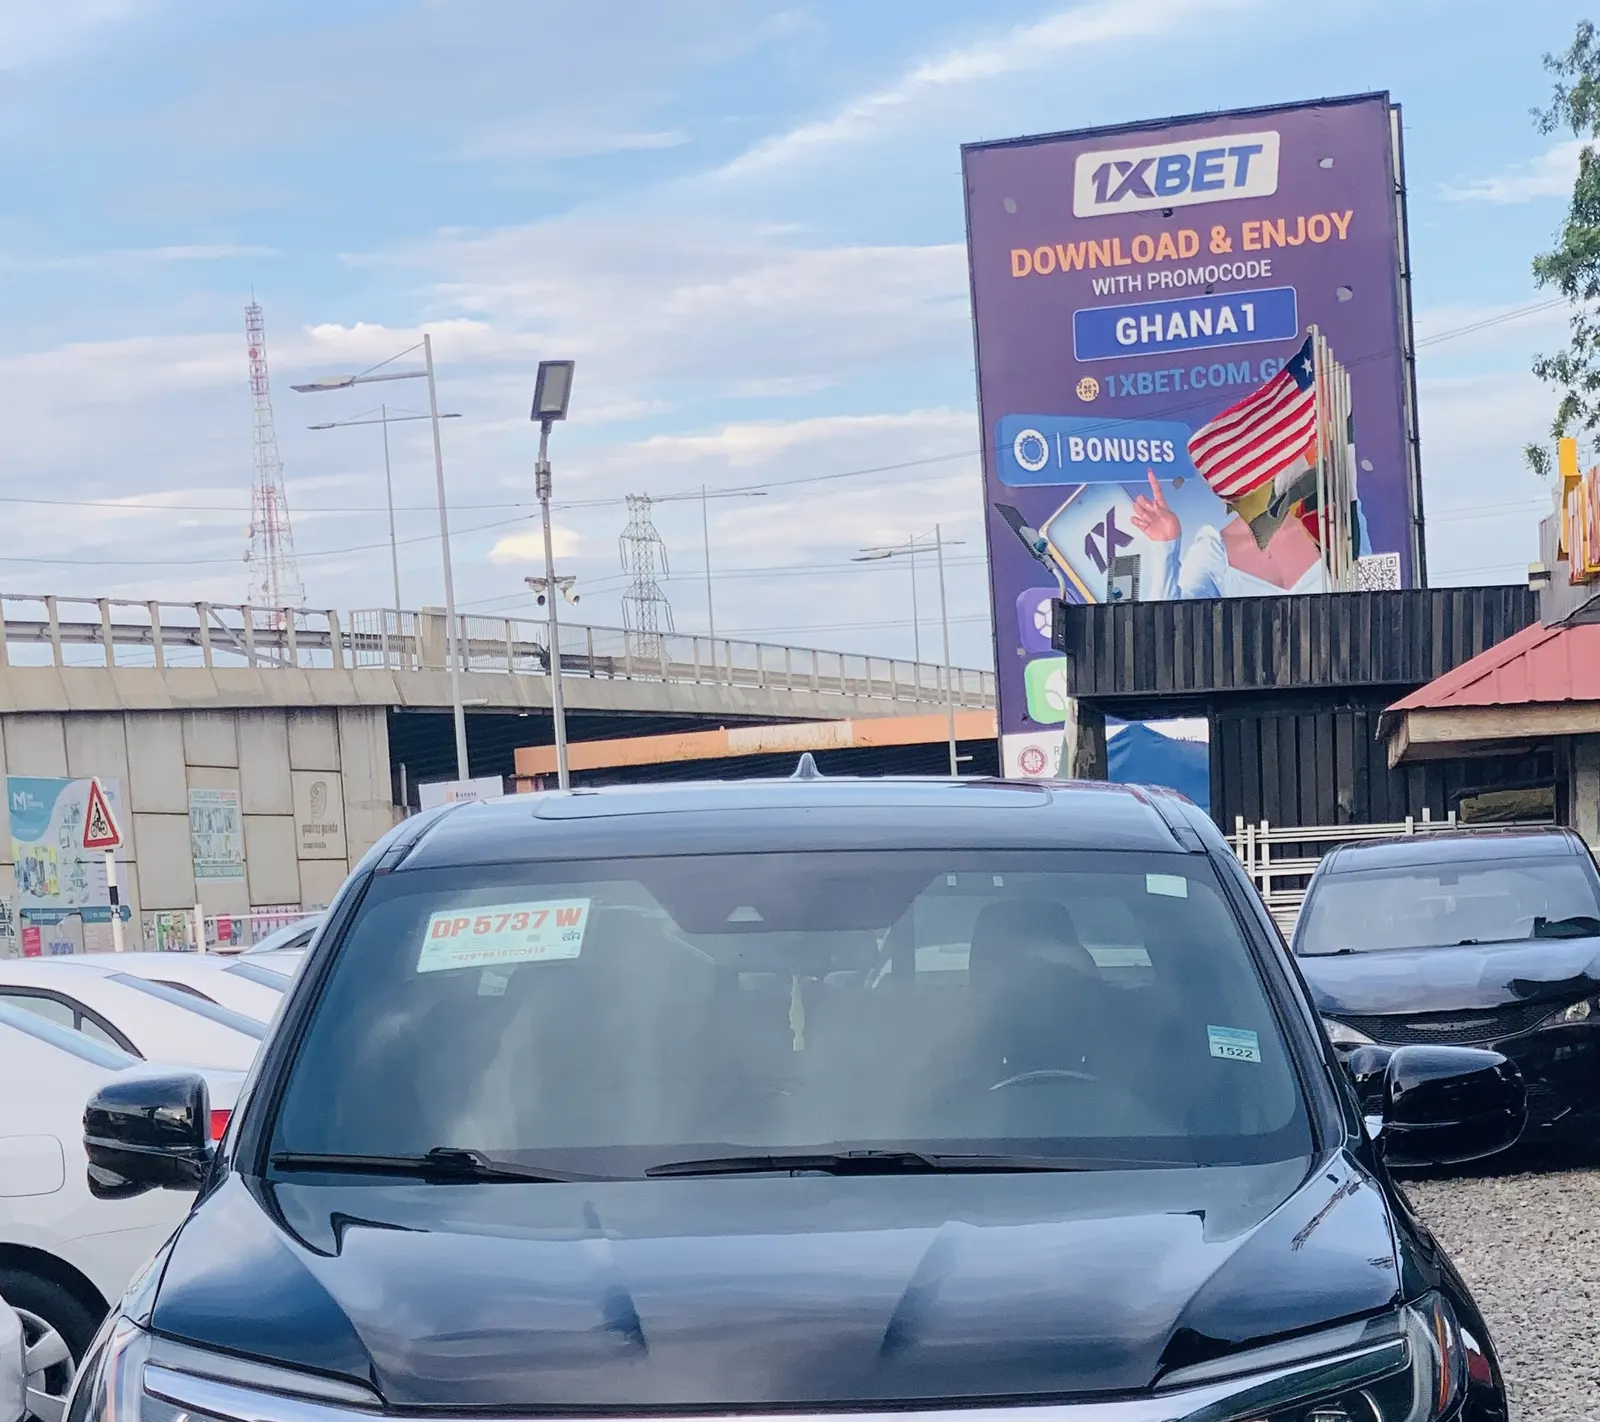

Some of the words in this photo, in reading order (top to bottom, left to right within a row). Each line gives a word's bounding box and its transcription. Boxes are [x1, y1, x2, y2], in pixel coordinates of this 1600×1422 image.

[1091, 144, 1263, 204] 1XBET
[1010, 229, 1200, 278] DOWNLOAD
[1210, 230, 1233, 255] &
[1242, 211, 1354, 251] ENJOY
[1092, 275, 1142, 296] WITH
[1147, 259, 1272, 292] PROMOCODE
[1069, 436, 1175, 463] BONUSES
[431, 918, 470, 939] DP
[473, 910, 549, 935] 5737
[555, 908, 583, 927] W
[1218, 1046, 1253, 1058] 1522
